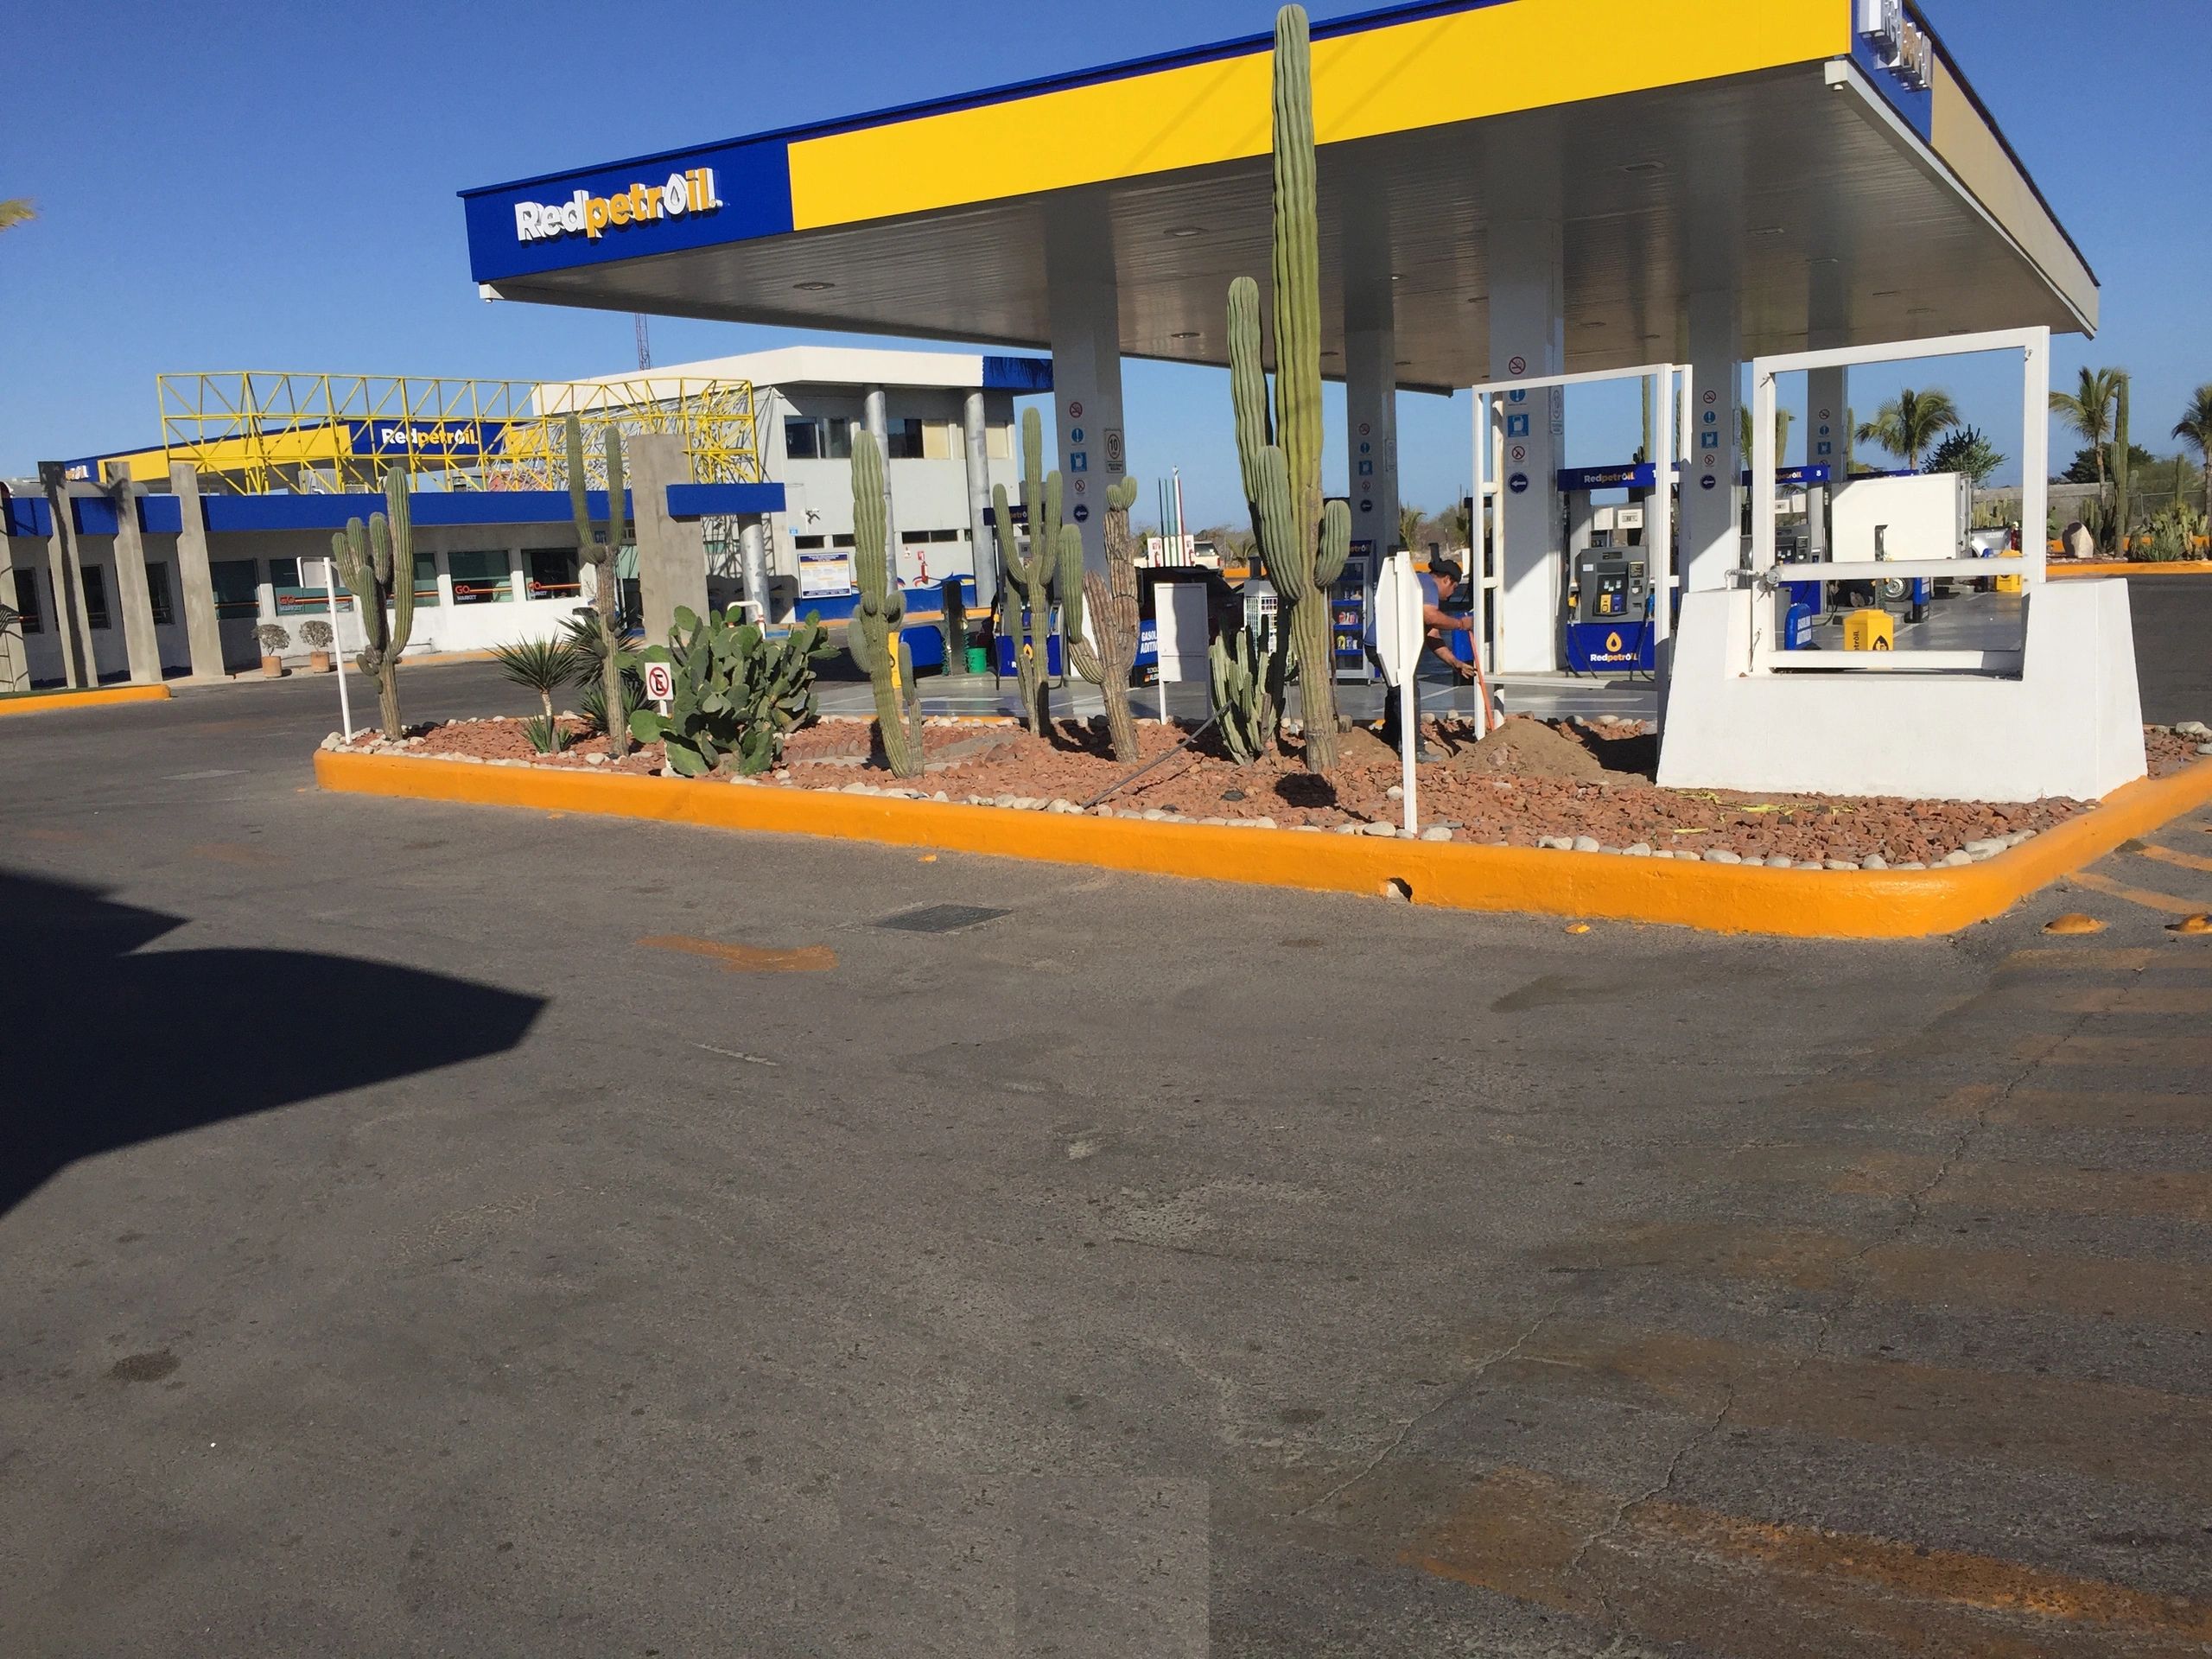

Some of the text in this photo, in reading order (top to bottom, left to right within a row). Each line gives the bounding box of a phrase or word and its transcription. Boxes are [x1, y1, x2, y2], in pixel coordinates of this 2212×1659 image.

[1109, 438, 1118, 451] 10
[454, 585, 470, 594] GO
[1141, 630, 1158, 642] GASOL
